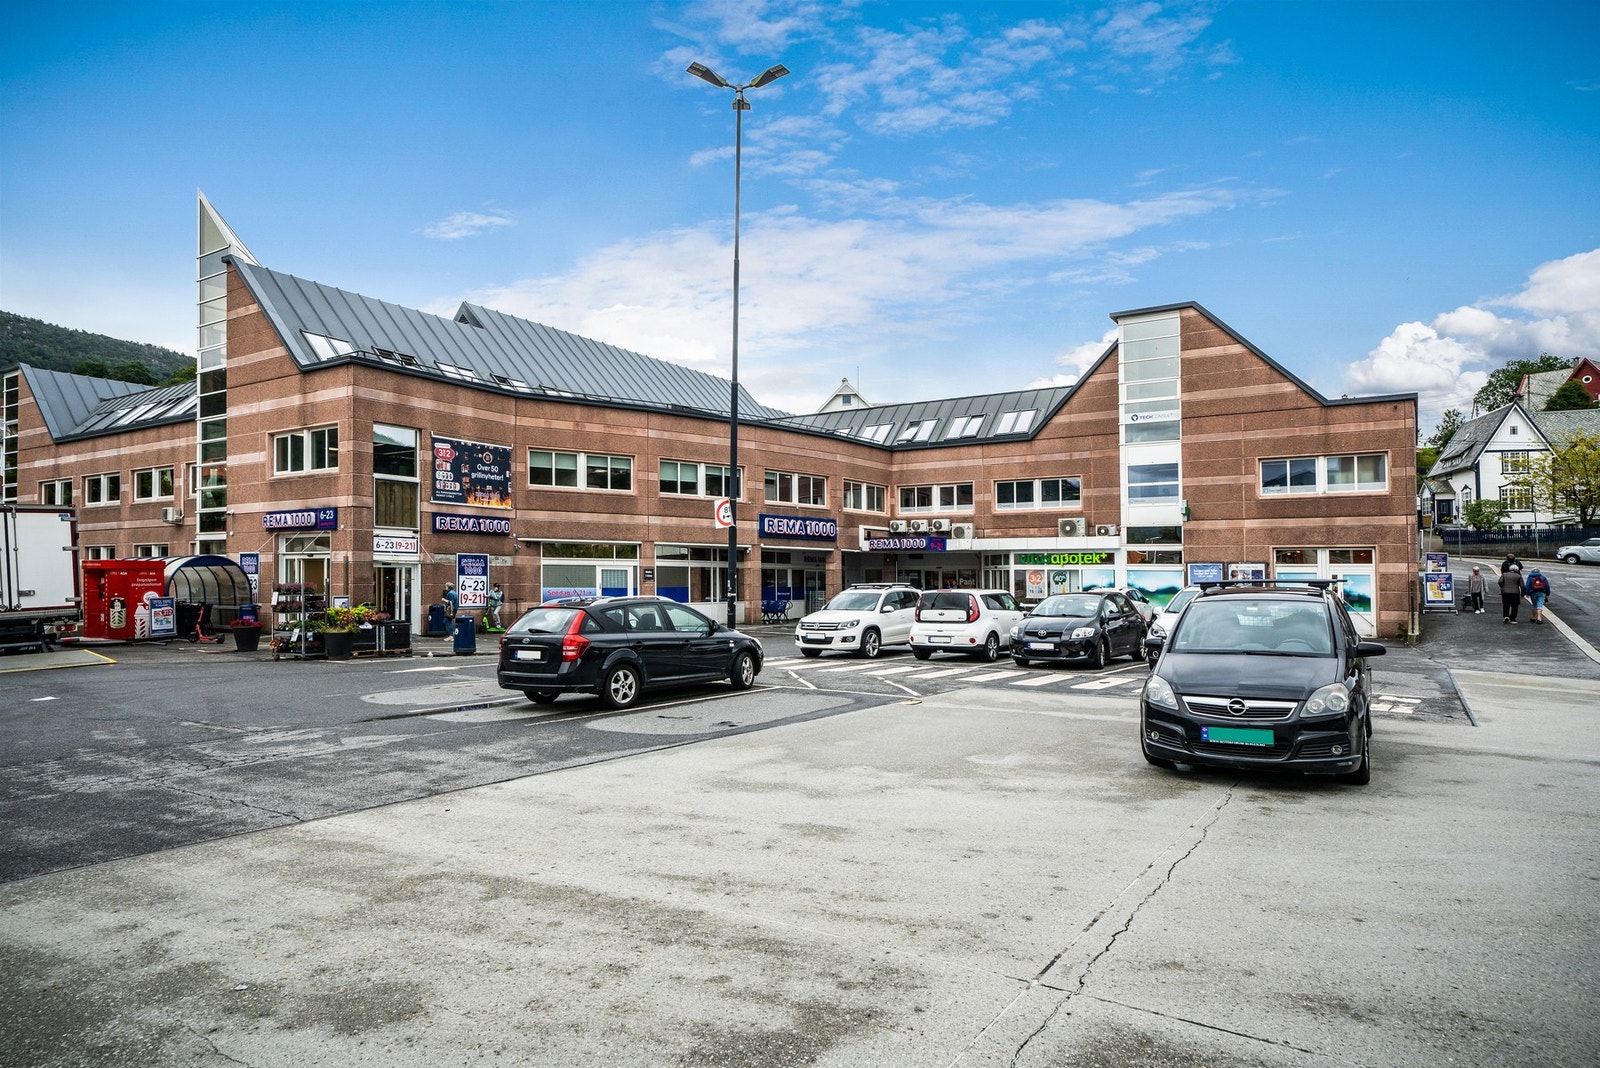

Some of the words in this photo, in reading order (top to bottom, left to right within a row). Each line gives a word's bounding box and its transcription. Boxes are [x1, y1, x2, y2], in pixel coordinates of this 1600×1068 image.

[476, 463, 490, 472] Over
[262, 513, 291, 528] REMA
[291, 512, 316, 527] 1000
[320, 510, 334, 520] 6-23
[436, 516, 479, 532] REMA
[480, 518, 511, 534] 1000
[765, 517, 805, 535] REMA
[805, 520, 836, 537] 1000
[376, 541, 394, 549] 6-23
[395, 541, 416, 550] (9-21)
[869, 539, 900, 549] REMA
[901, 538, 926, 549] 1000
[461, 558, 485, 567] REMA
[464, 566, 483, 575] 1000
[460, 580, 486, 591] 6-23
[460, 593, 486, 604] (9-21)
